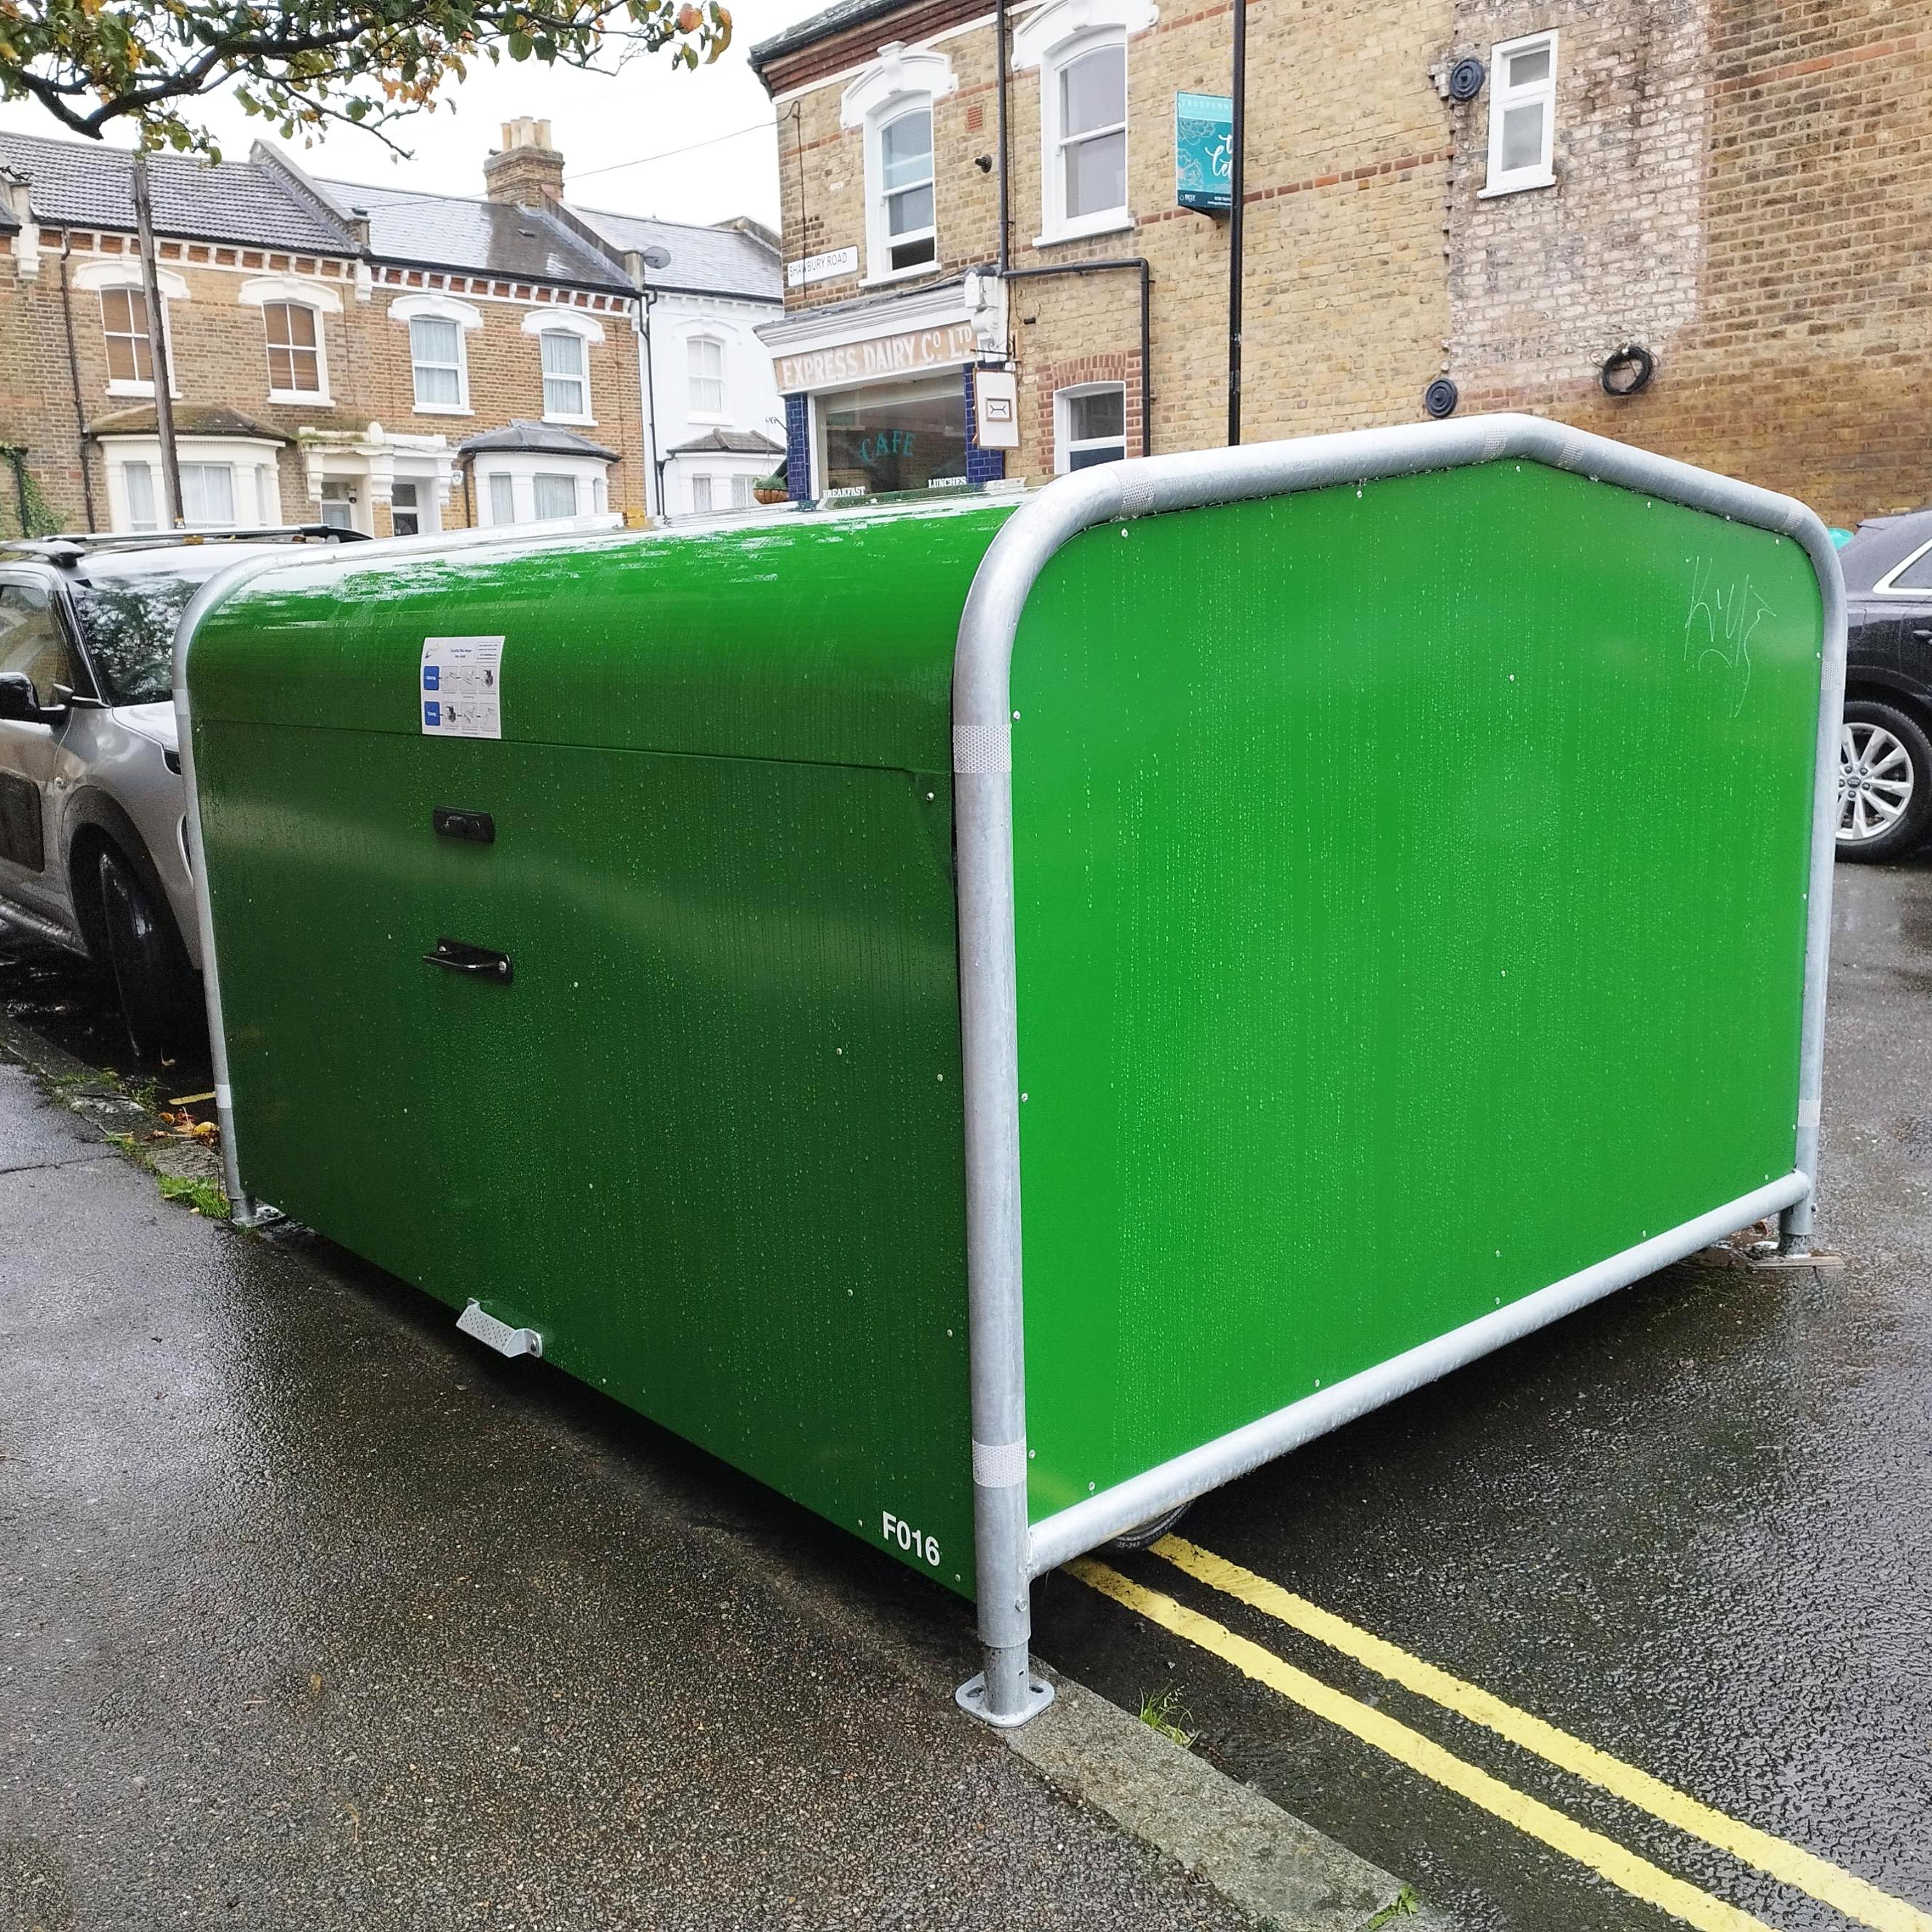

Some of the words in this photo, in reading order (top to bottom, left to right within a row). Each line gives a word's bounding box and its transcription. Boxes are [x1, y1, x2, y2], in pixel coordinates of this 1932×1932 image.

[827, 252, 847, 267] ROAD
[783, 349, 857, 386] EXPRESS
[862, 336, 915, 373] DAIRY
[861, 429, 915, 463] CAFE
[823, 486, 865, 498] BREAKFAST
[928, 476, 967, 488] LUNCHES
[883, 1511, 940, 1566] F016
